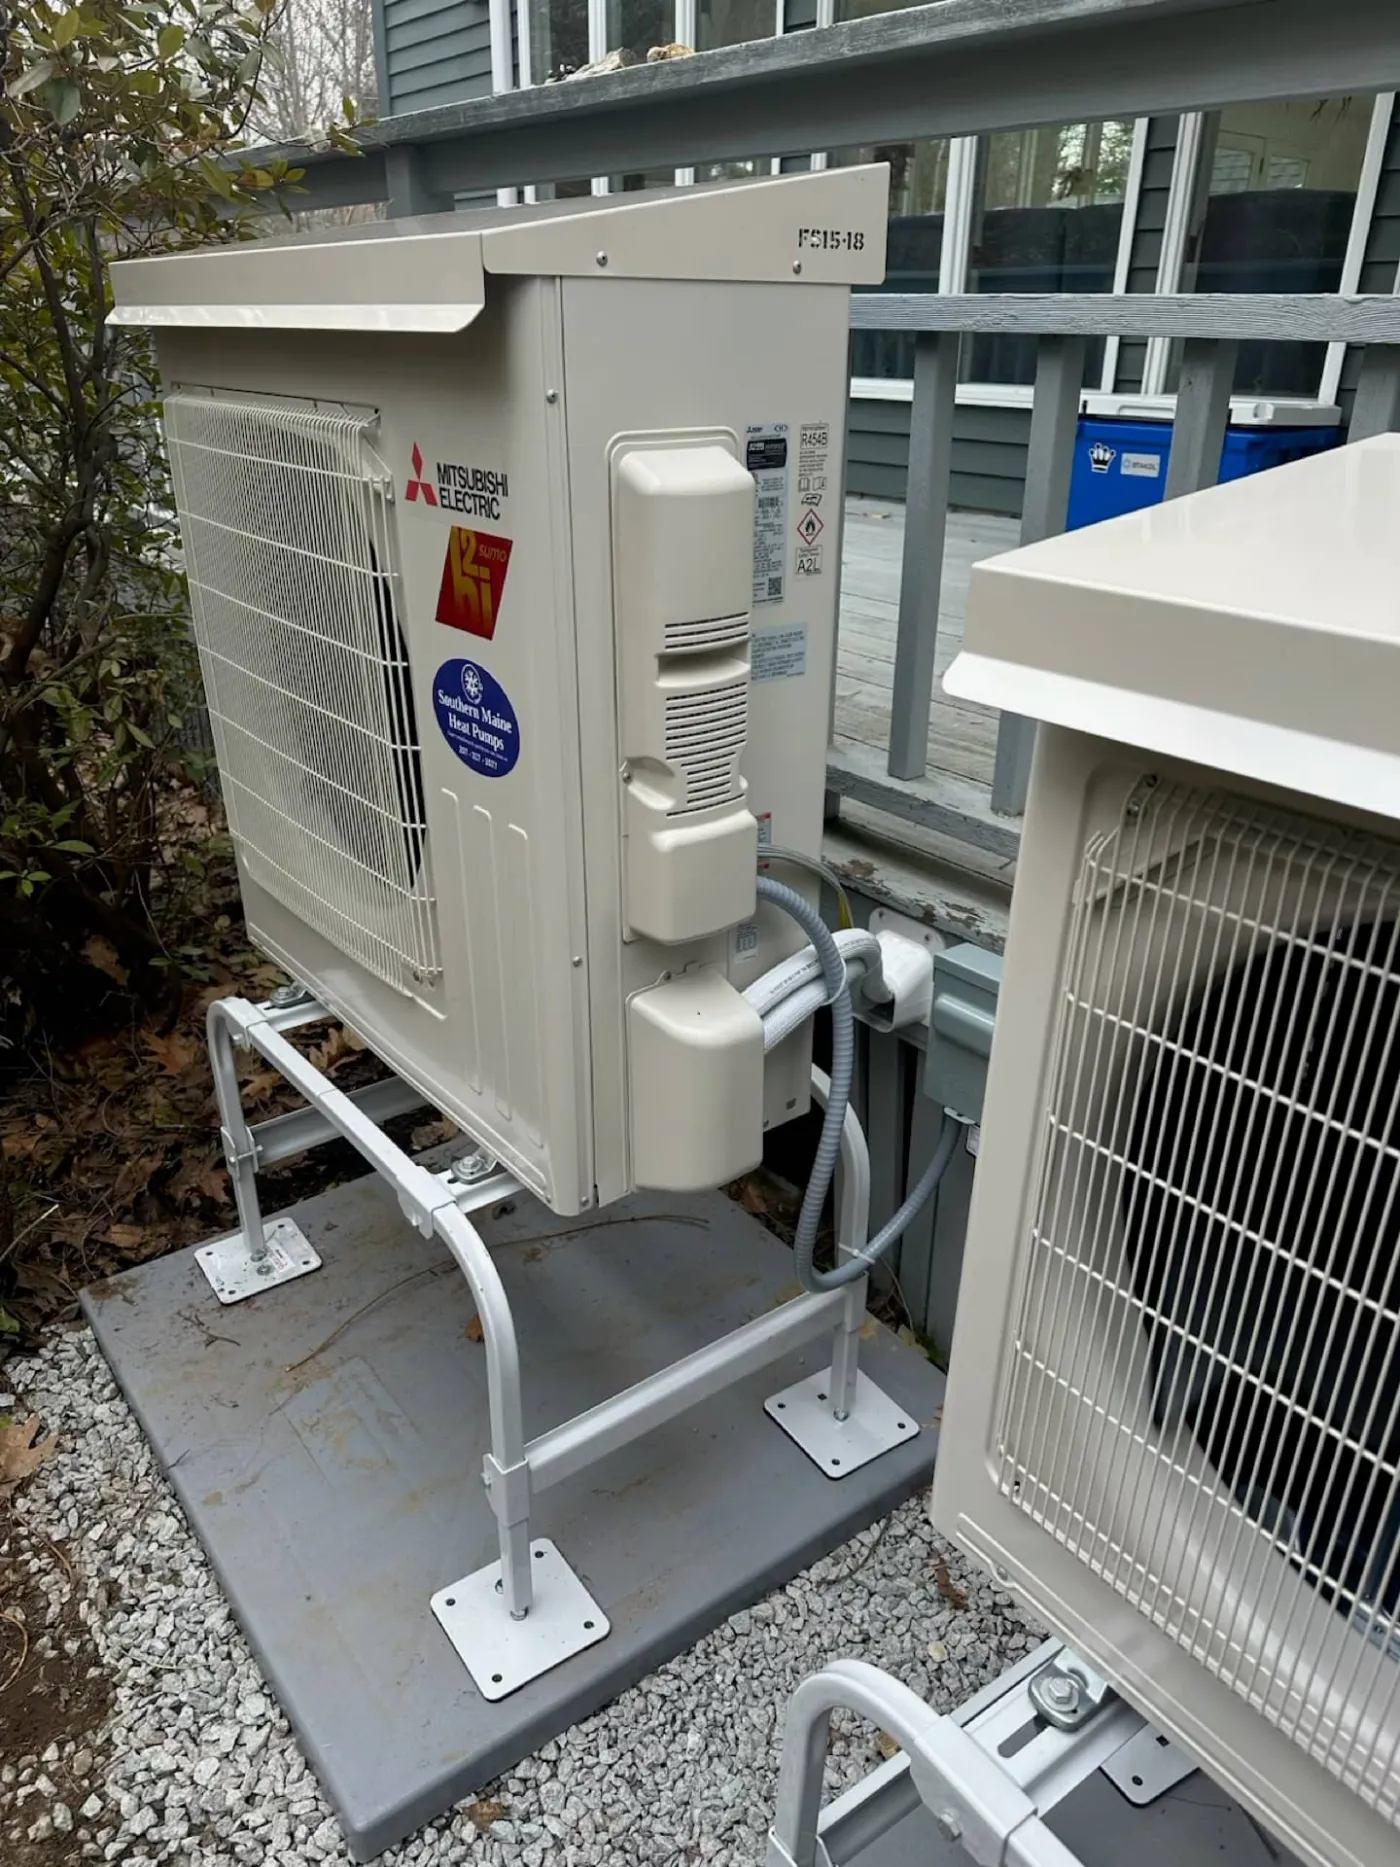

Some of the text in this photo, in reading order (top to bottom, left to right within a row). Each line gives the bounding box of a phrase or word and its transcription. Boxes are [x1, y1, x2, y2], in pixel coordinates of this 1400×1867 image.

[801, 432, 828, 448] R454B
[436, 462, 509, 497] MITSUBISHI
[439, 488, 501, 521] ELECTRIC
[478, 544, 508, 563] sumo
[797, 558, 820, 574] A2L
[437, 689, 513, 734] Southern Maine
[447, 712, 471, 736] Heat
[471, 723, 505, 752] Pumps
